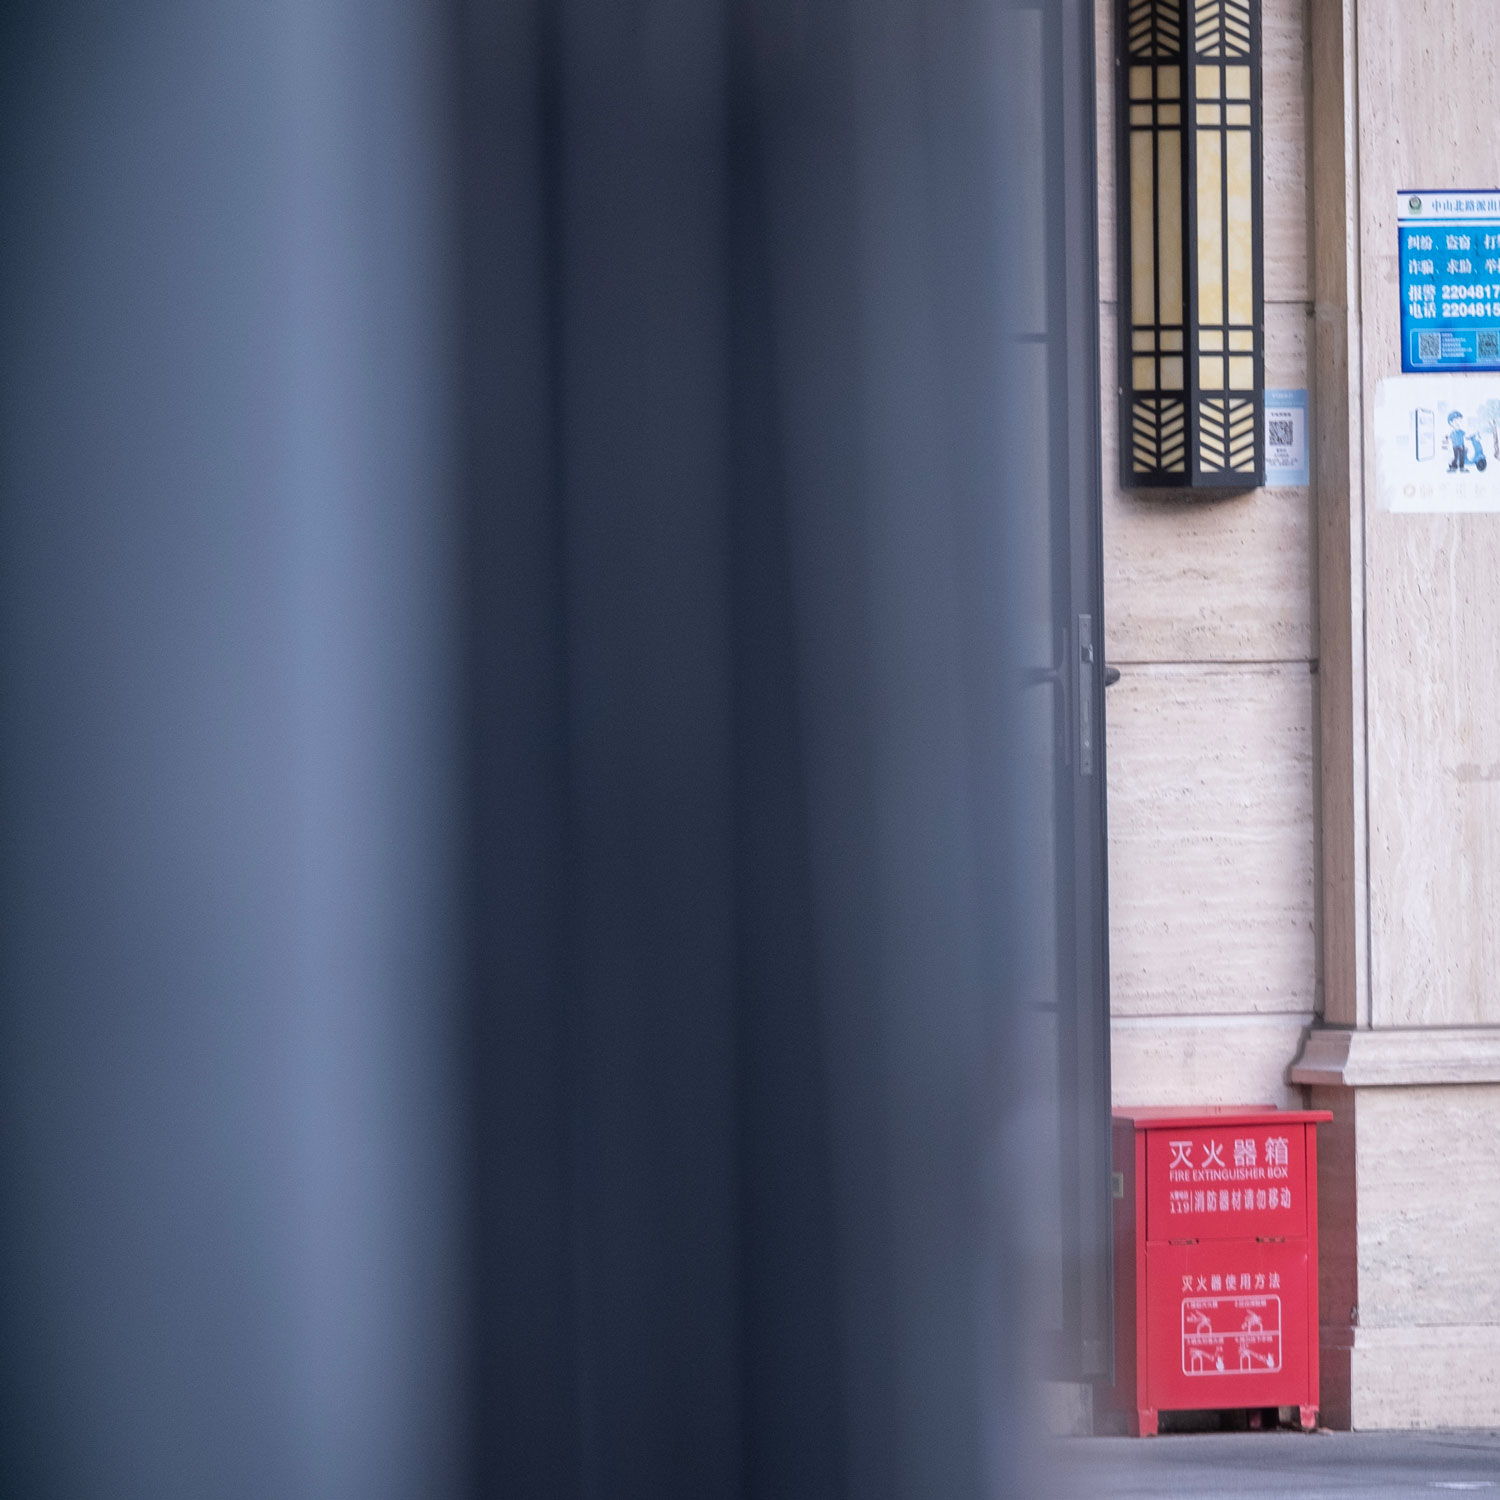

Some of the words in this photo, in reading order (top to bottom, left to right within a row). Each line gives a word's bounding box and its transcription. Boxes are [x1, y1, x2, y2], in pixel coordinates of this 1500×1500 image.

[1408, 284, 1436, 302] 报警
[1409, 302, 1436, 318] 电话
[1169, 1136, 1289, 1169] 灭火器箱
[1169, 1169, 1190, 1182] FIRE
[1192, 1168, 1265, 1182] EXTINGUISHER
[1267, 1166, 1288, 1179] BOX
[1170, 1201, 1190, 1214] 119
[1194, 1186, 1291, 1213] 消防器材请勿移动
[1181, 1272, 1280, 1293] 灭火器使用方法
